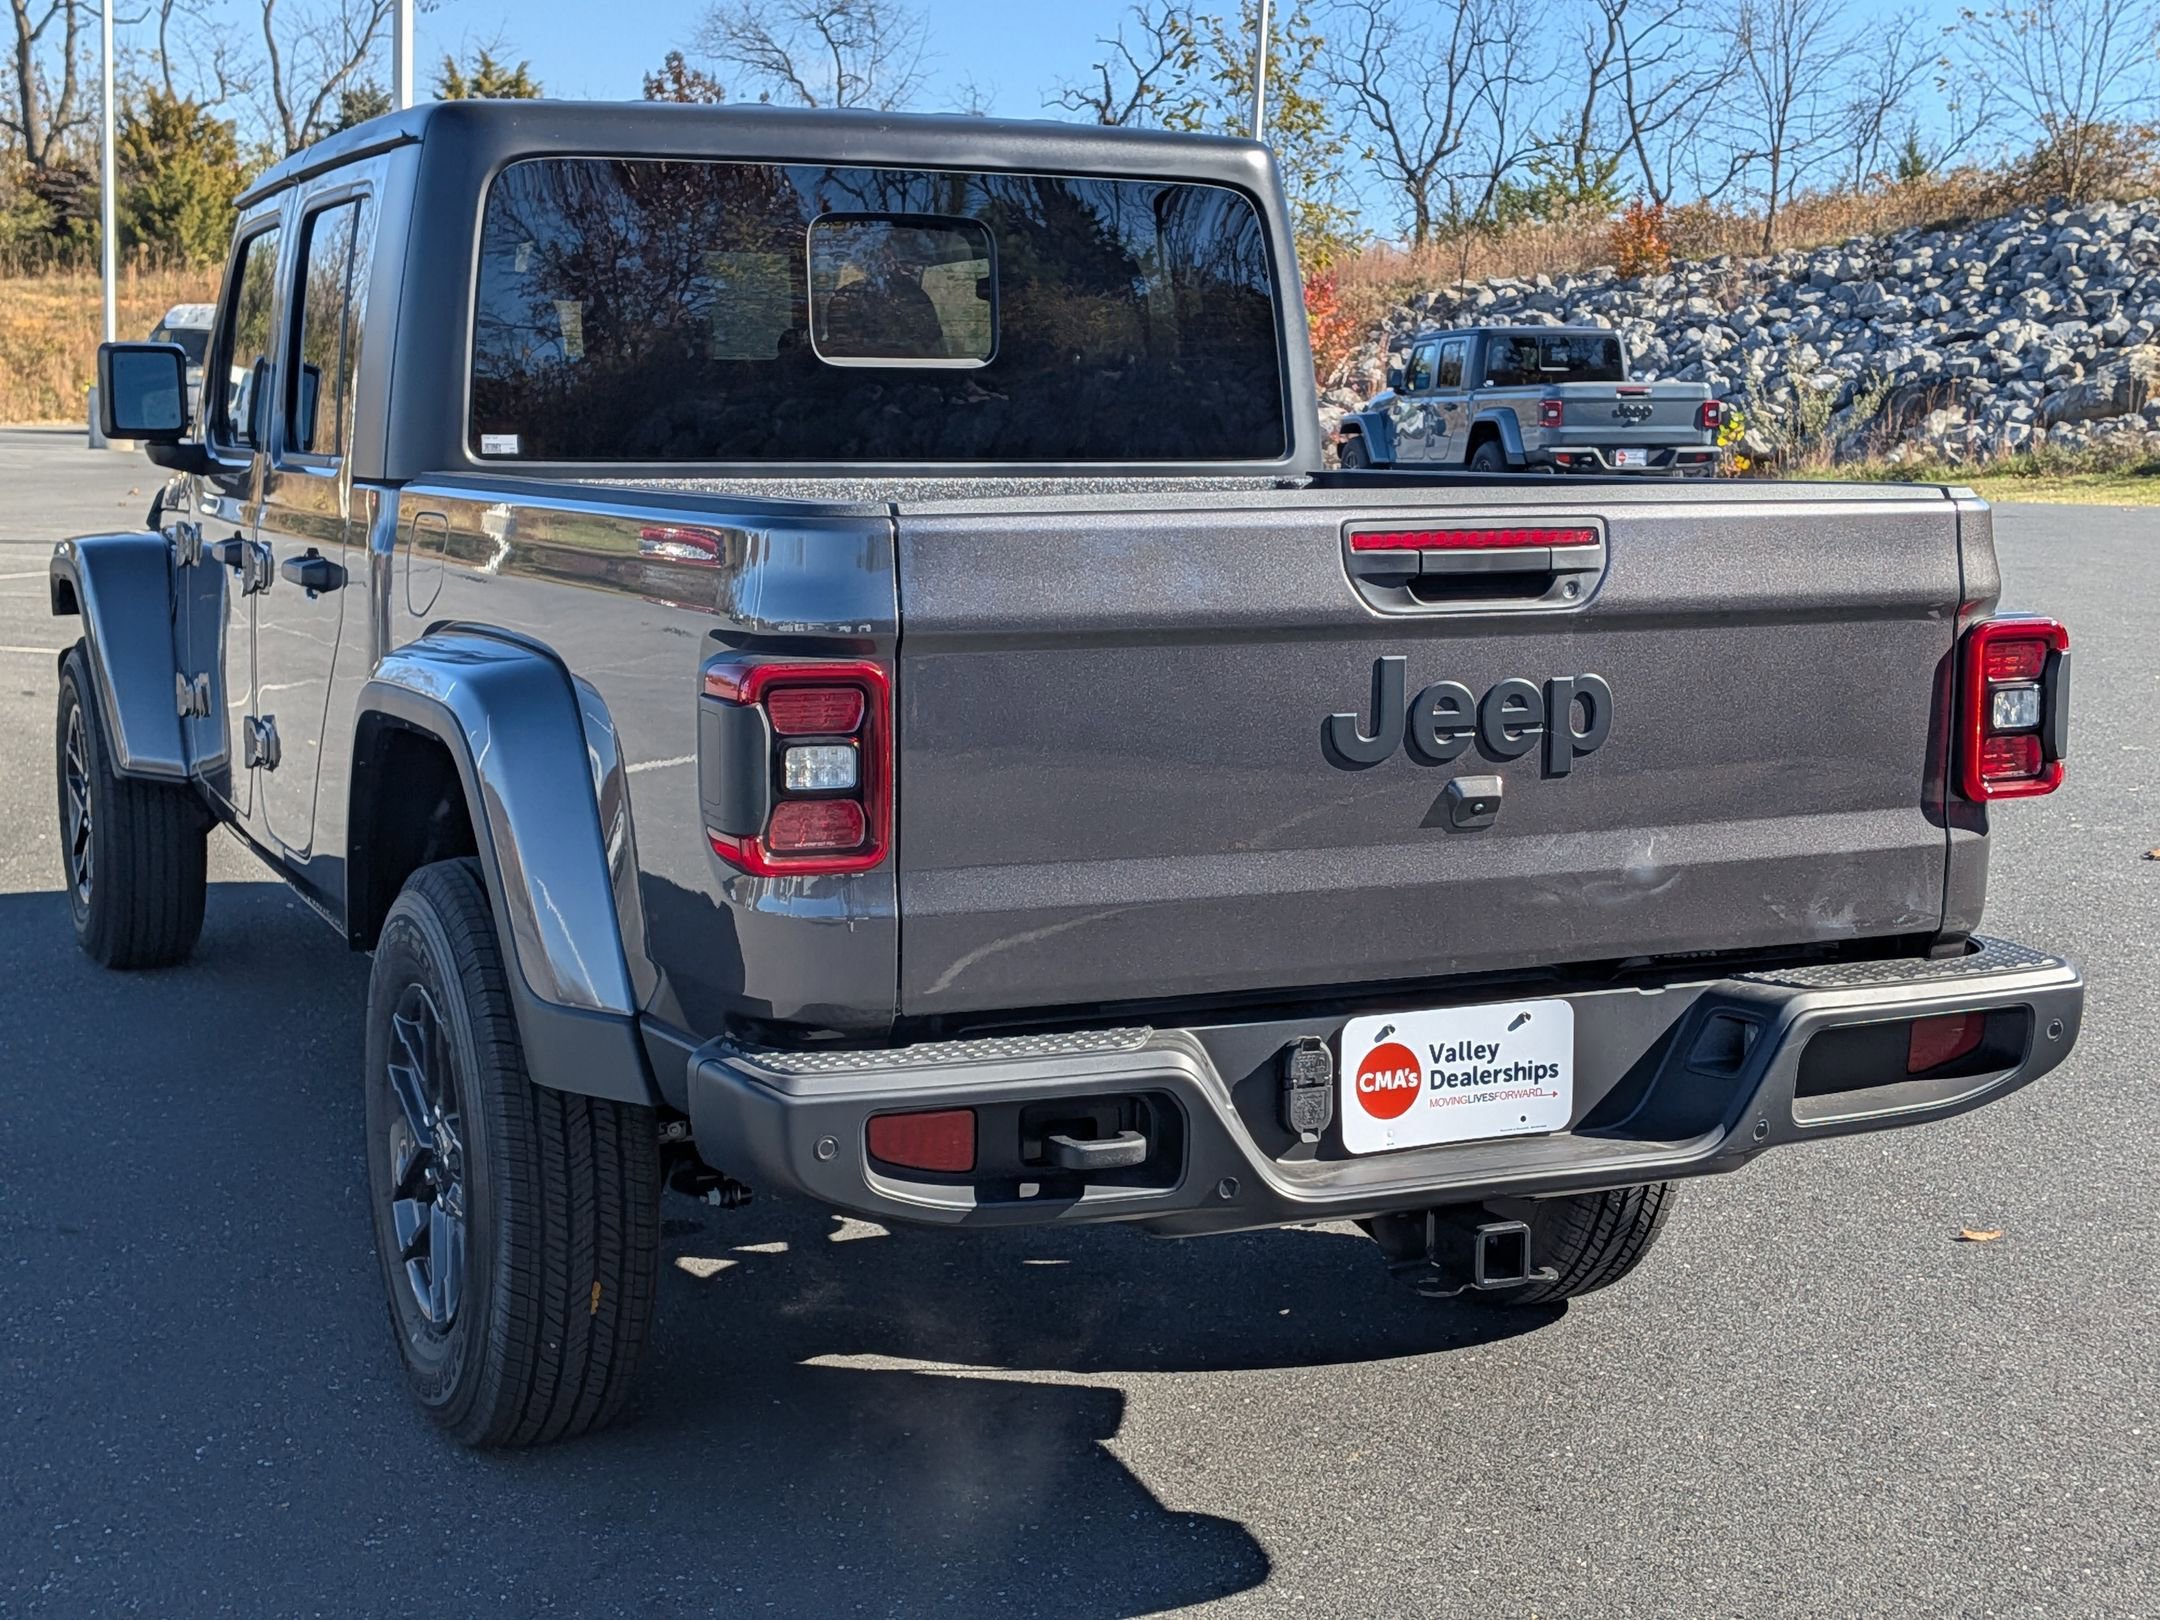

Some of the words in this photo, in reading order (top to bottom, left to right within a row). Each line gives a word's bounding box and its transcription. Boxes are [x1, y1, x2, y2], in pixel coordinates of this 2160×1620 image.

[1328, 655, 1614, 775] Jeep
[1429, 1040, 1500, 1065] Valley
[1359, 1067, 1419, 1093] CMA's
[1430, 1060, 1559, 1090] Dealerships
